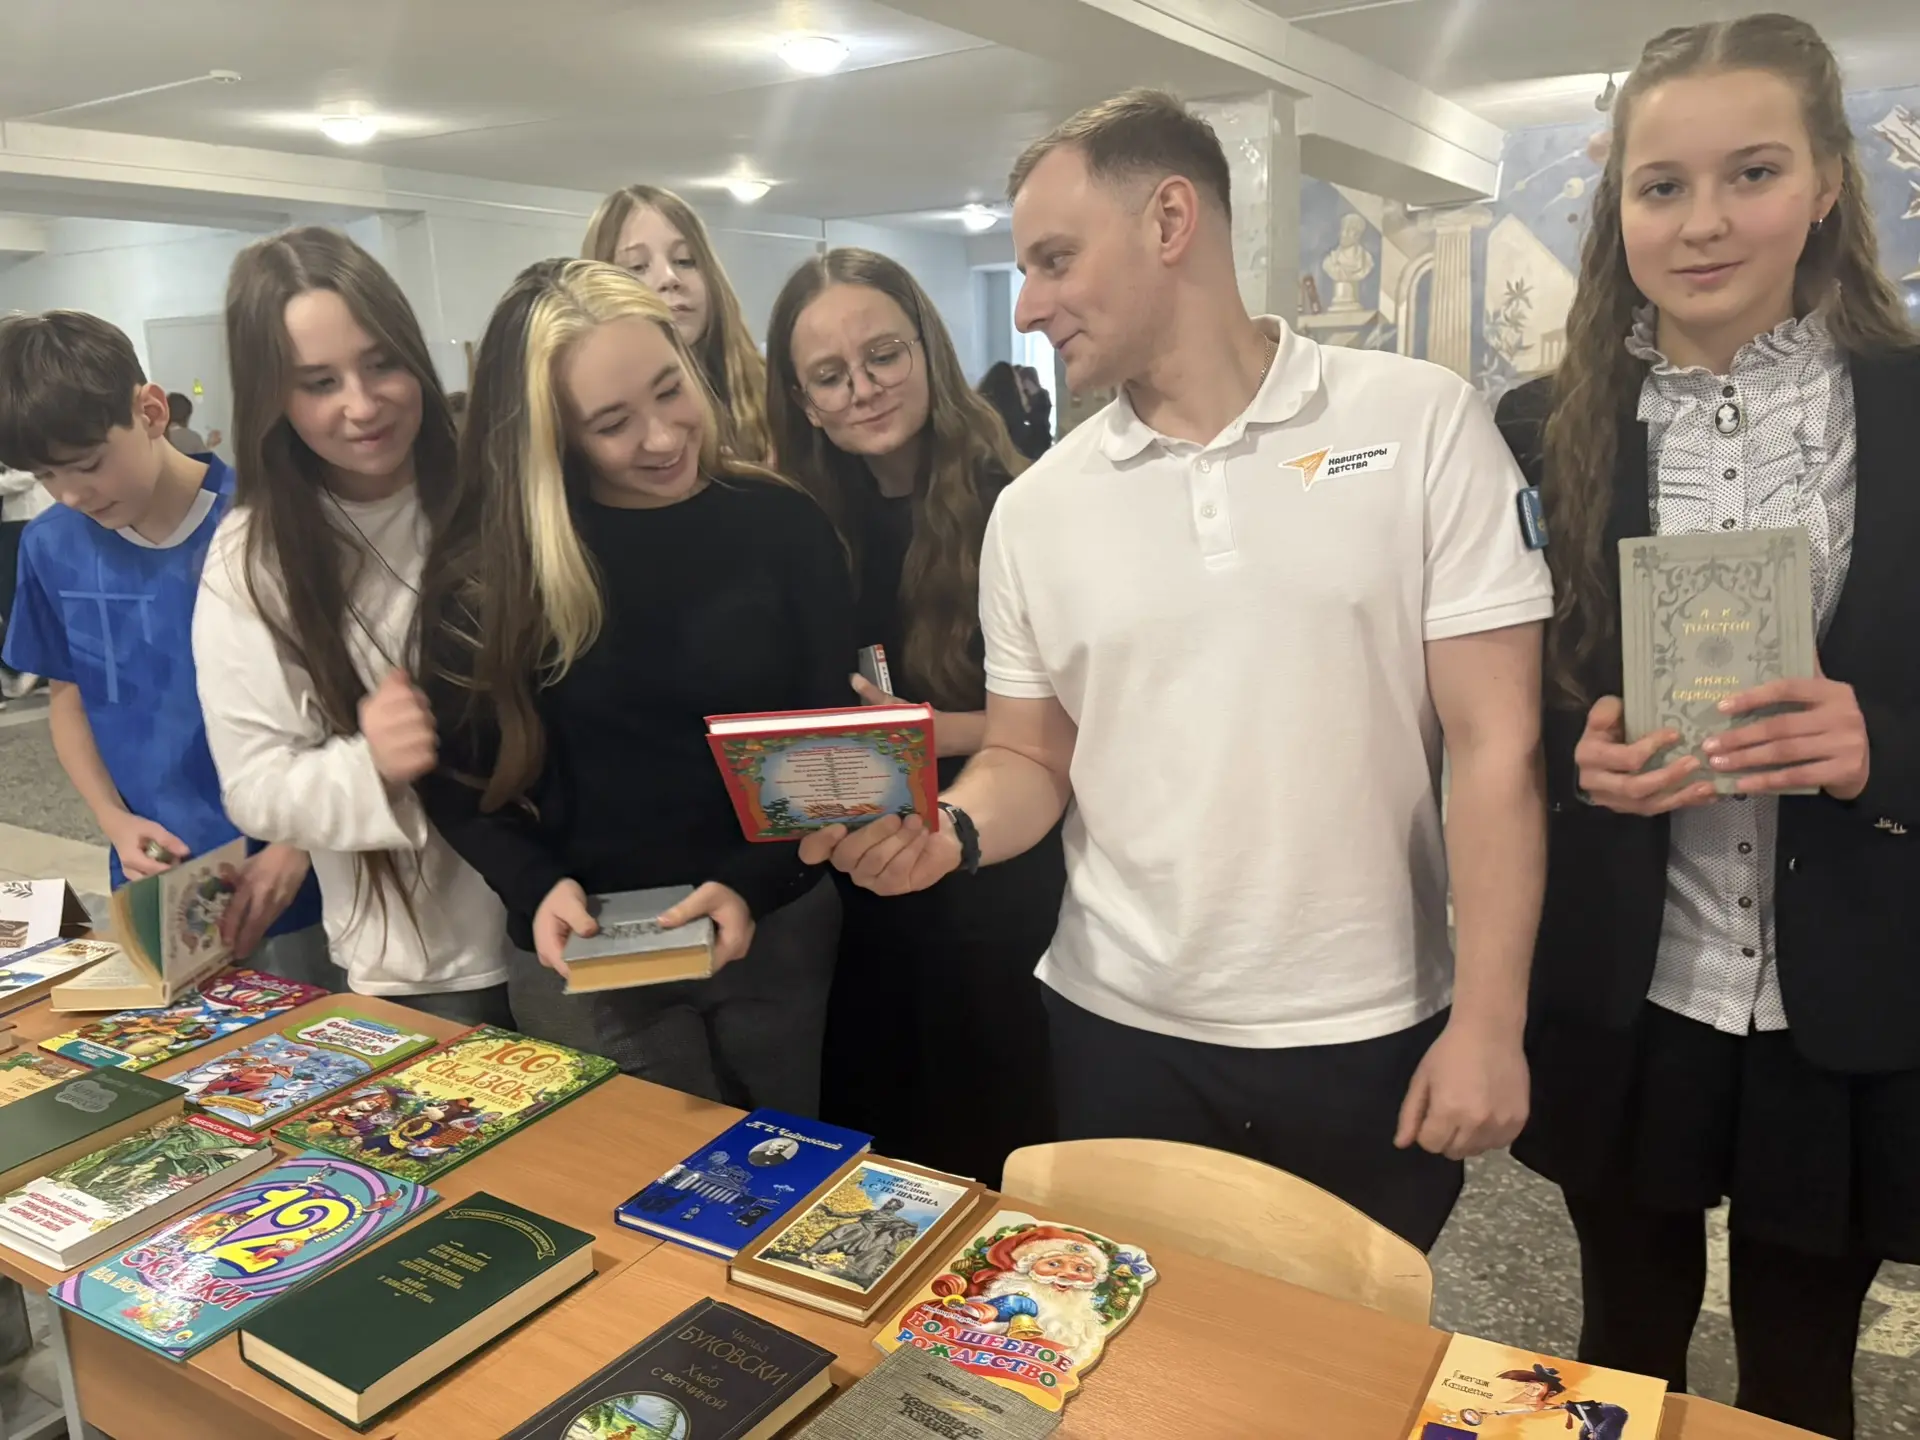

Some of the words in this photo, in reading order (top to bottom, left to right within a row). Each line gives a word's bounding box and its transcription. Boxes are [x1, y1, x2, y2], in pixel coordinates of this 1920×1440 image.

[1327, 461, 1368, 476] ДЕТСТВА
[1328, 448, 1388, 466] НАВИГАТОРЫ
[480, 1042, 561, 1074] 100
[880, 1184, 939, 1208] ПУШКИНА
[88, 1266, 115, 1284] НА
[732, 1327, 770, 1353] ЧАРЛЬЗ
[907, 1311, 1075, 1373] ВОЛШЕБНОЕ
[677, 1325, 788, 1386] БУКОВСКИ
[896, 1329, 1057, 1388] РОЖДЕСТВО
[681, 1363, 724, 1389] Хлеб
